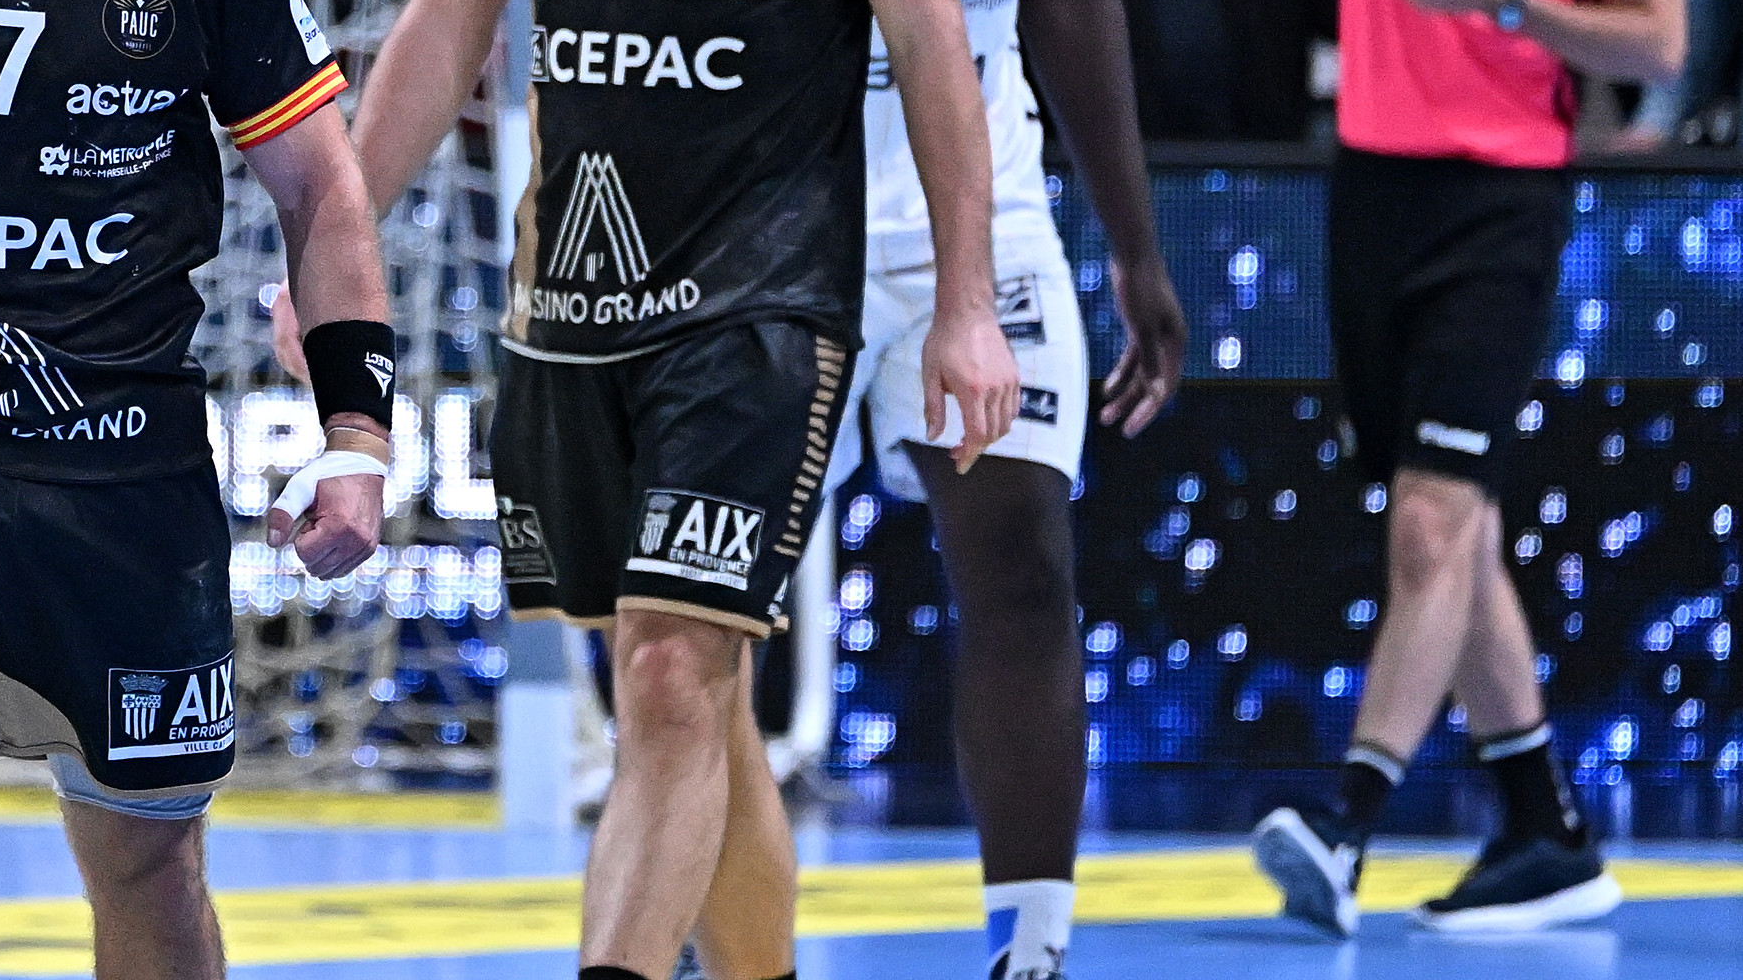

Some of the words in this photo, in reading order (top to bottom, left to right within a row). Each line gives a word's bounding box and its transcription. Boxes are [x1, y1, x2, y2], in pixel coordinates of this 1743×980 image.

[121, 10, 158, 37] PAUC
[549, 27, 746, 91] CEPAC
[65, 80, 189, 116] actua
[593, 277, 701, 325] GRAND
[672, 499, 761, 562] AIX
[171, 658, 234, 726] AIX
[168, 726, 188, 740] EN
[183, 741, 209, 753] VILLE
